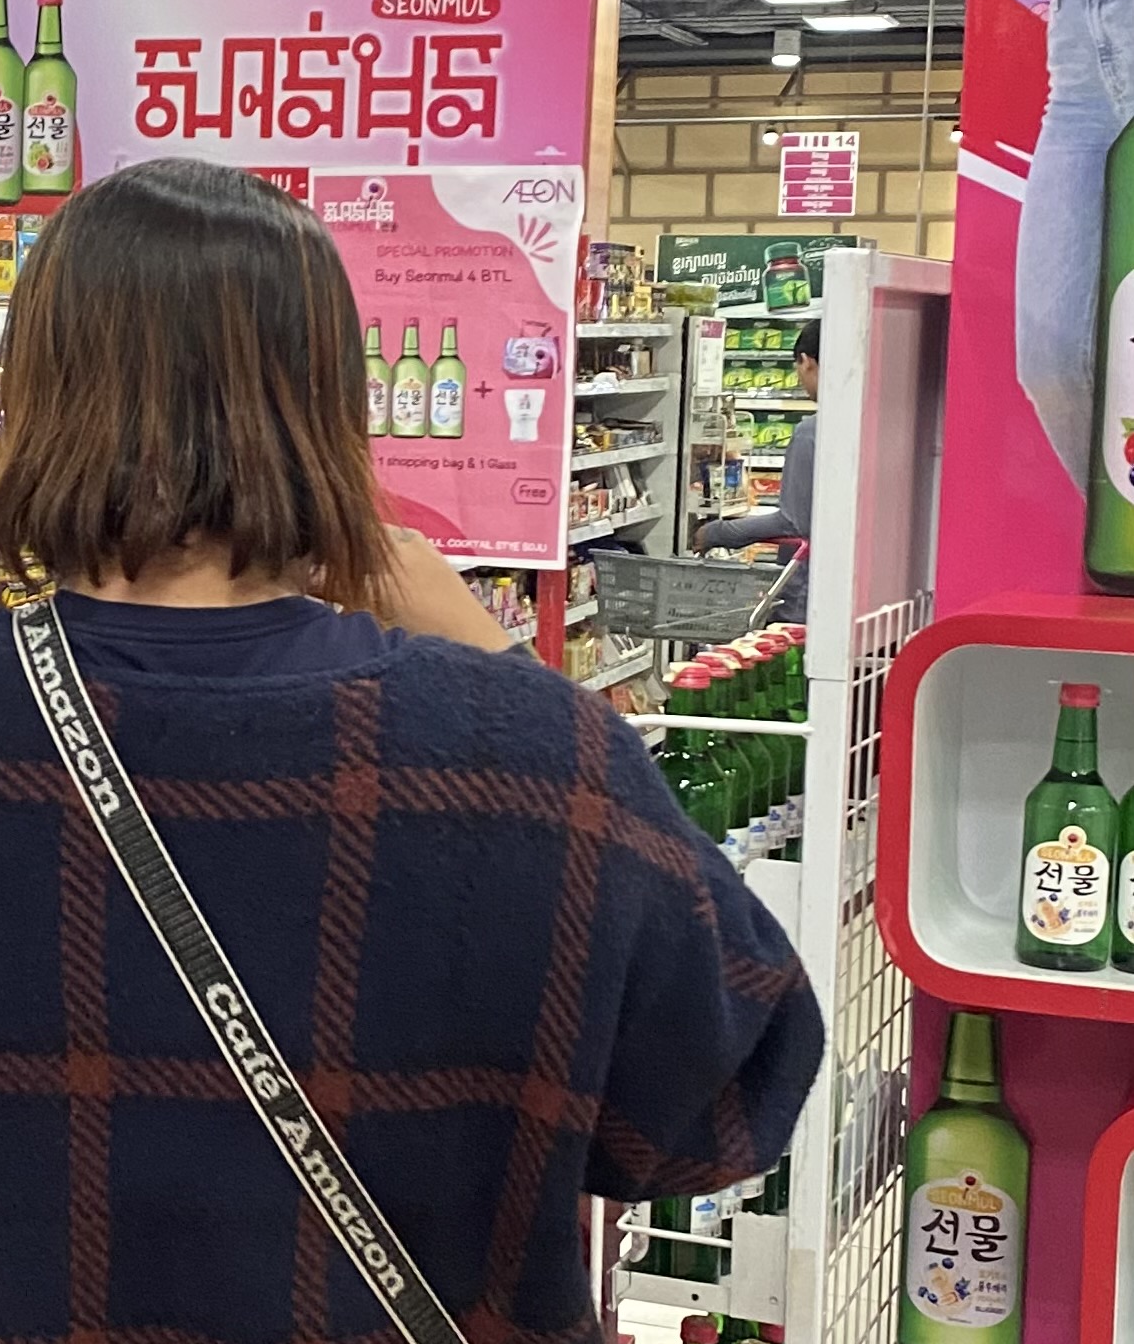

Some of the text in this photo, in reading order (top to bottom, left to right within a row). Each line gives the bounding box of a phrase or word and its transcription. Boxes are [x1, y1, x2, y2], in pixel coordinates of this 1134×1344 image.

[26, 117, 68, 140] 선물
[835, 135, 855, 147] 14
[376, 244, 515, 257] SPECIAL PROMOTION
[375, 269, 513, 285] Buy Seonmul 4 BTL
[434, 389, 460, 406] 선물
[387, 457, 438, 471] shopping
[442, 457, 464, 471] bag
[467, 457, 476, 468] &
[487, 459, 517, 470] Glass
[519, 484, 547, 498] Free
[22, 622, 120, 819] Amazon
[1034, 861, 1099, 896] 선물
[206, 980, 404, 1299] Café Amazon
[921, 1208, 1008, 1263] 선물
